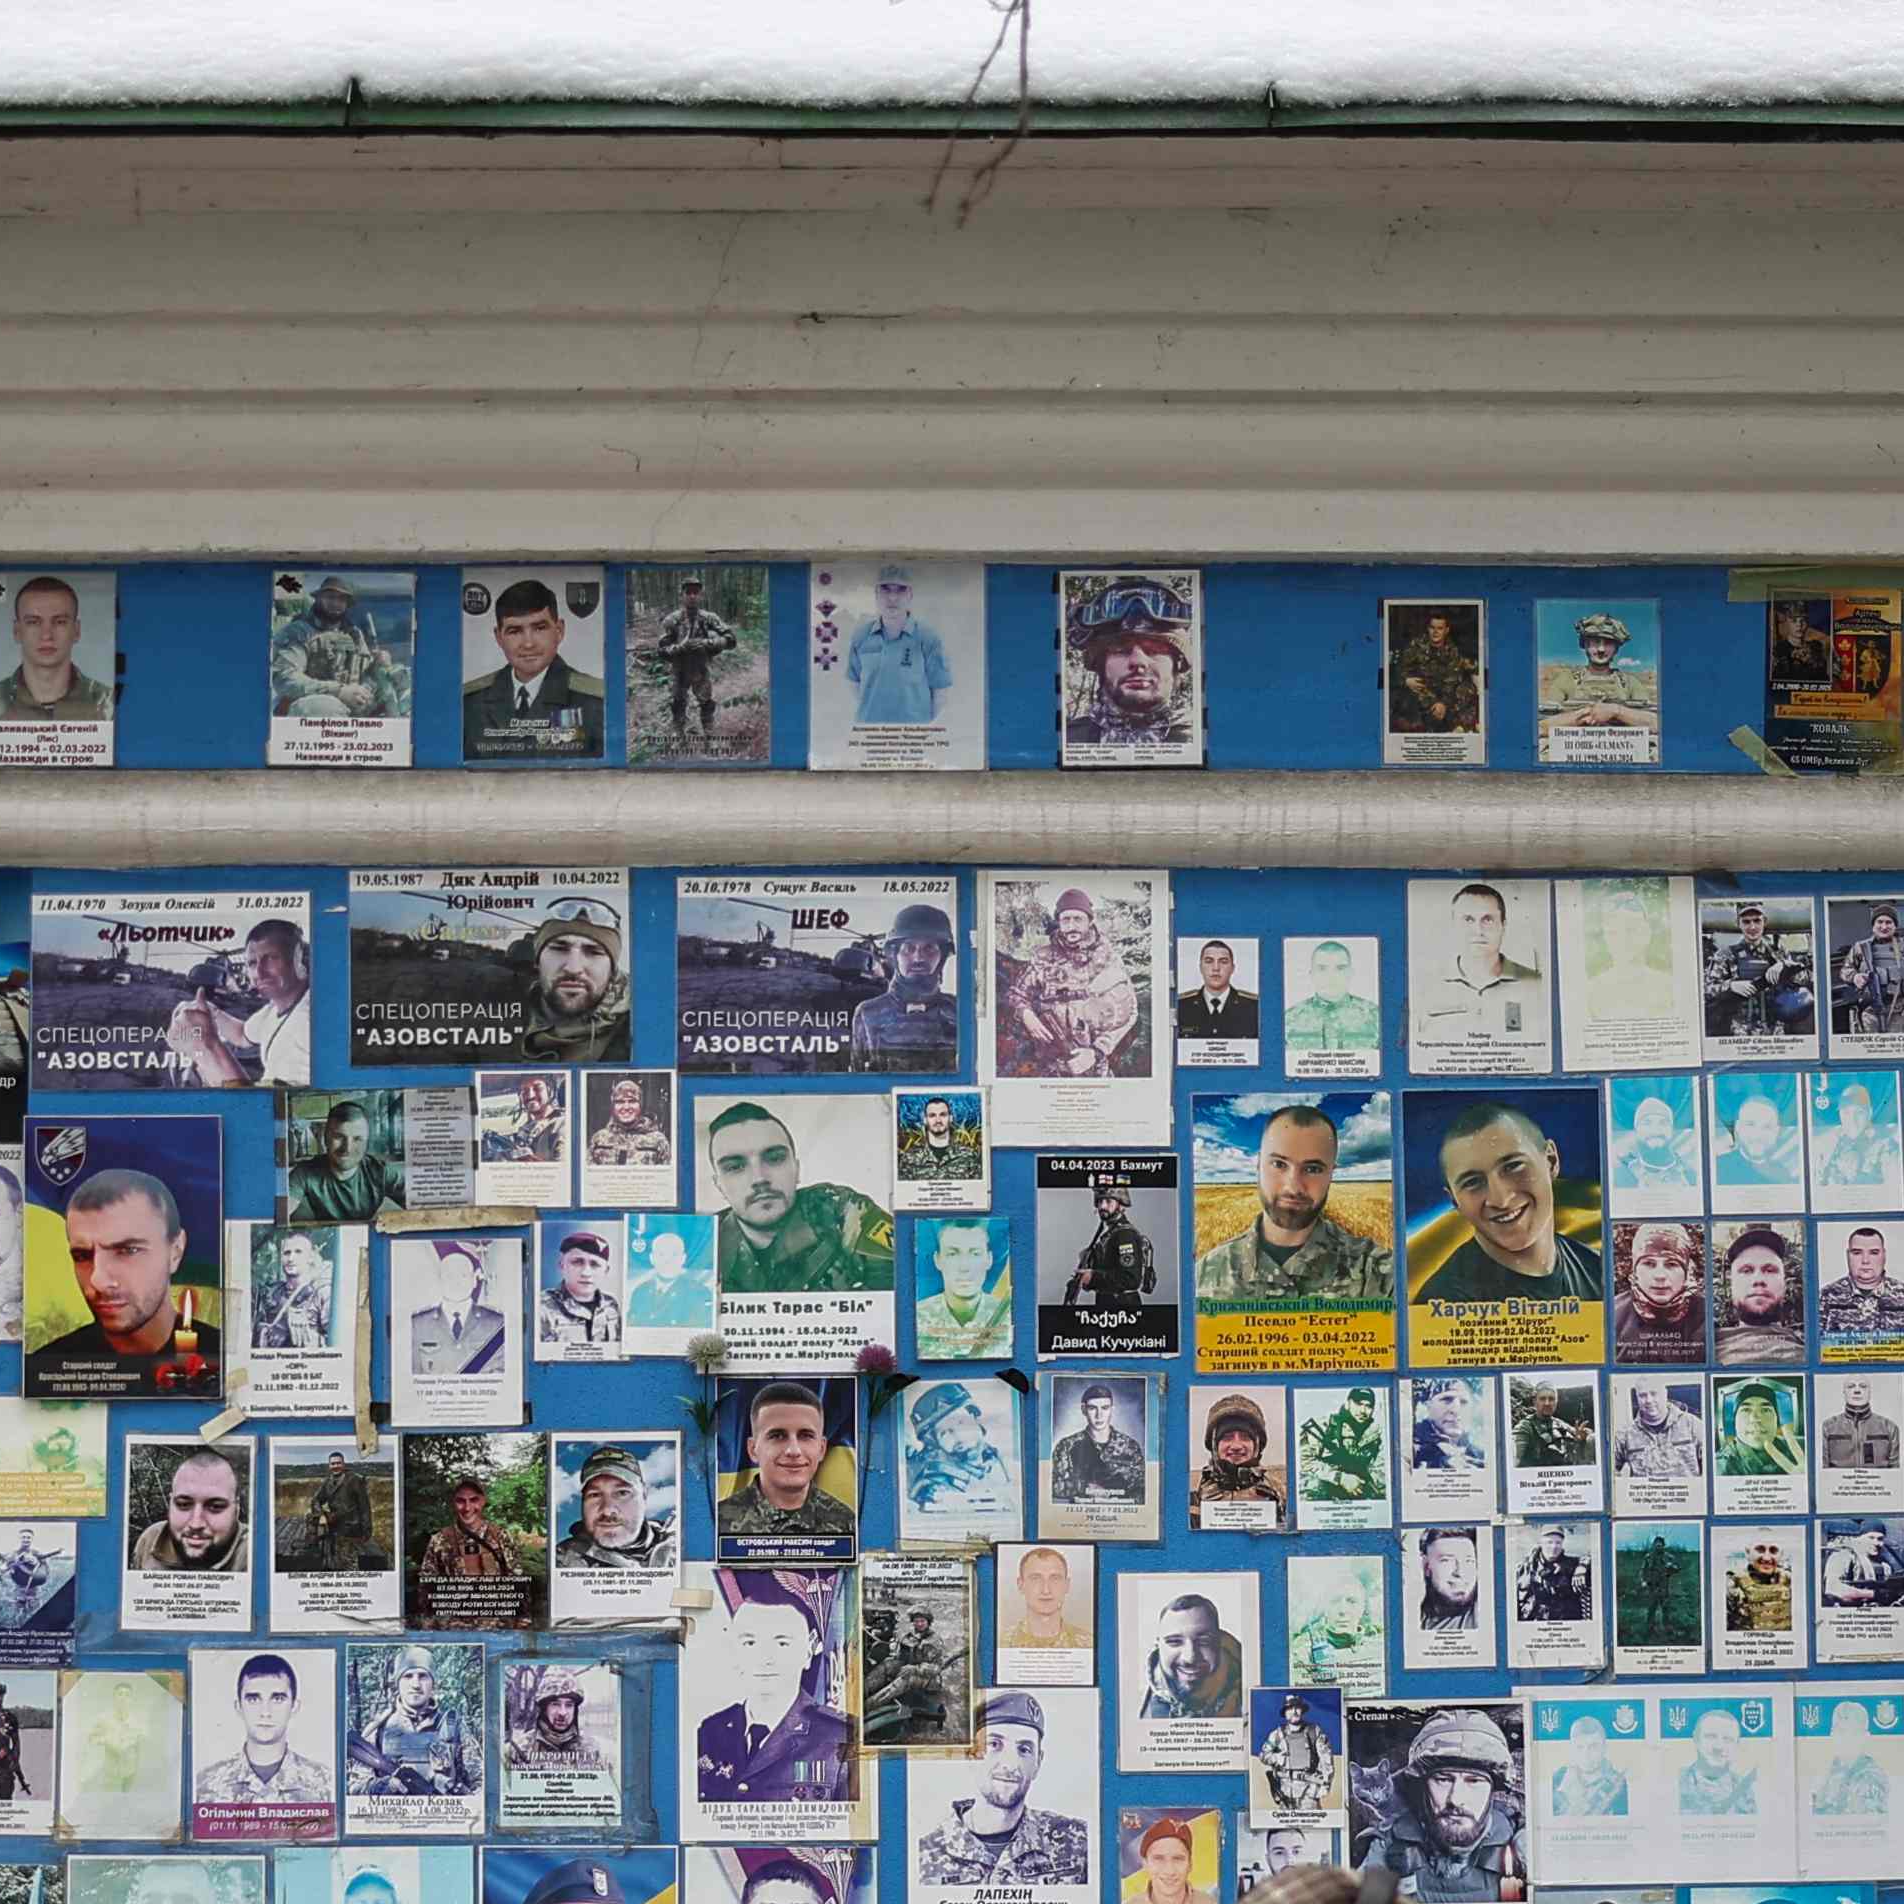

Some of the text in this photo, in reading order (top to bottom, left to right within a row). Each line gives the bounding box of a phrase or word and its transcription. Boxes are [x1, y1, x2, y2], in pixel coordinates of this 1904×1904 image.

[355, 872, 620, 890] 19.05.1987 Дяк Андрій 10.04.2022
[684, 882, 949, 895] 20.10.1978 Сущук Василь 18.05.2022
[39, 897, 303, 911] 11.04.1970 Зозуля Олексій 31.03.2022
[447, 895, 534, 912] Юрійович
[791, 909, 849, 929] ШЕФ
[98, 925, 235, 943] «Льотчик»
[356, 1002, 522, 1022] СПЕЦОПЕРАЦІЯ
[682, 1011, 848, 1029] СПЕЦОПЕРАЦІЯ
[356, 1027, 524, 1046] "АЗОВСТАЛЬ"
[682, 1036, 850, 1053] "АЗОВСТАЛЬ"
[1051, 1160, 1163, 1171] 04.04.2023 Бахмут
[720, 1302, 824, 1315] Білик Тарас
[1430, 1298, 1580, 1319] Харчук Віталій
[1217, 1332, 1376, 1344] 26.02.1996 03.04.2022
[1449, 1327, 1556, 1337] 19.09.1999-02.04.2022
[1051, 1336, 1166, 1350] Давид Кучукіані
[199, 1807, 329, 1818] Огільчин Владислав
[974, 1889, 1033, 1900] ЛАПЕХІН
